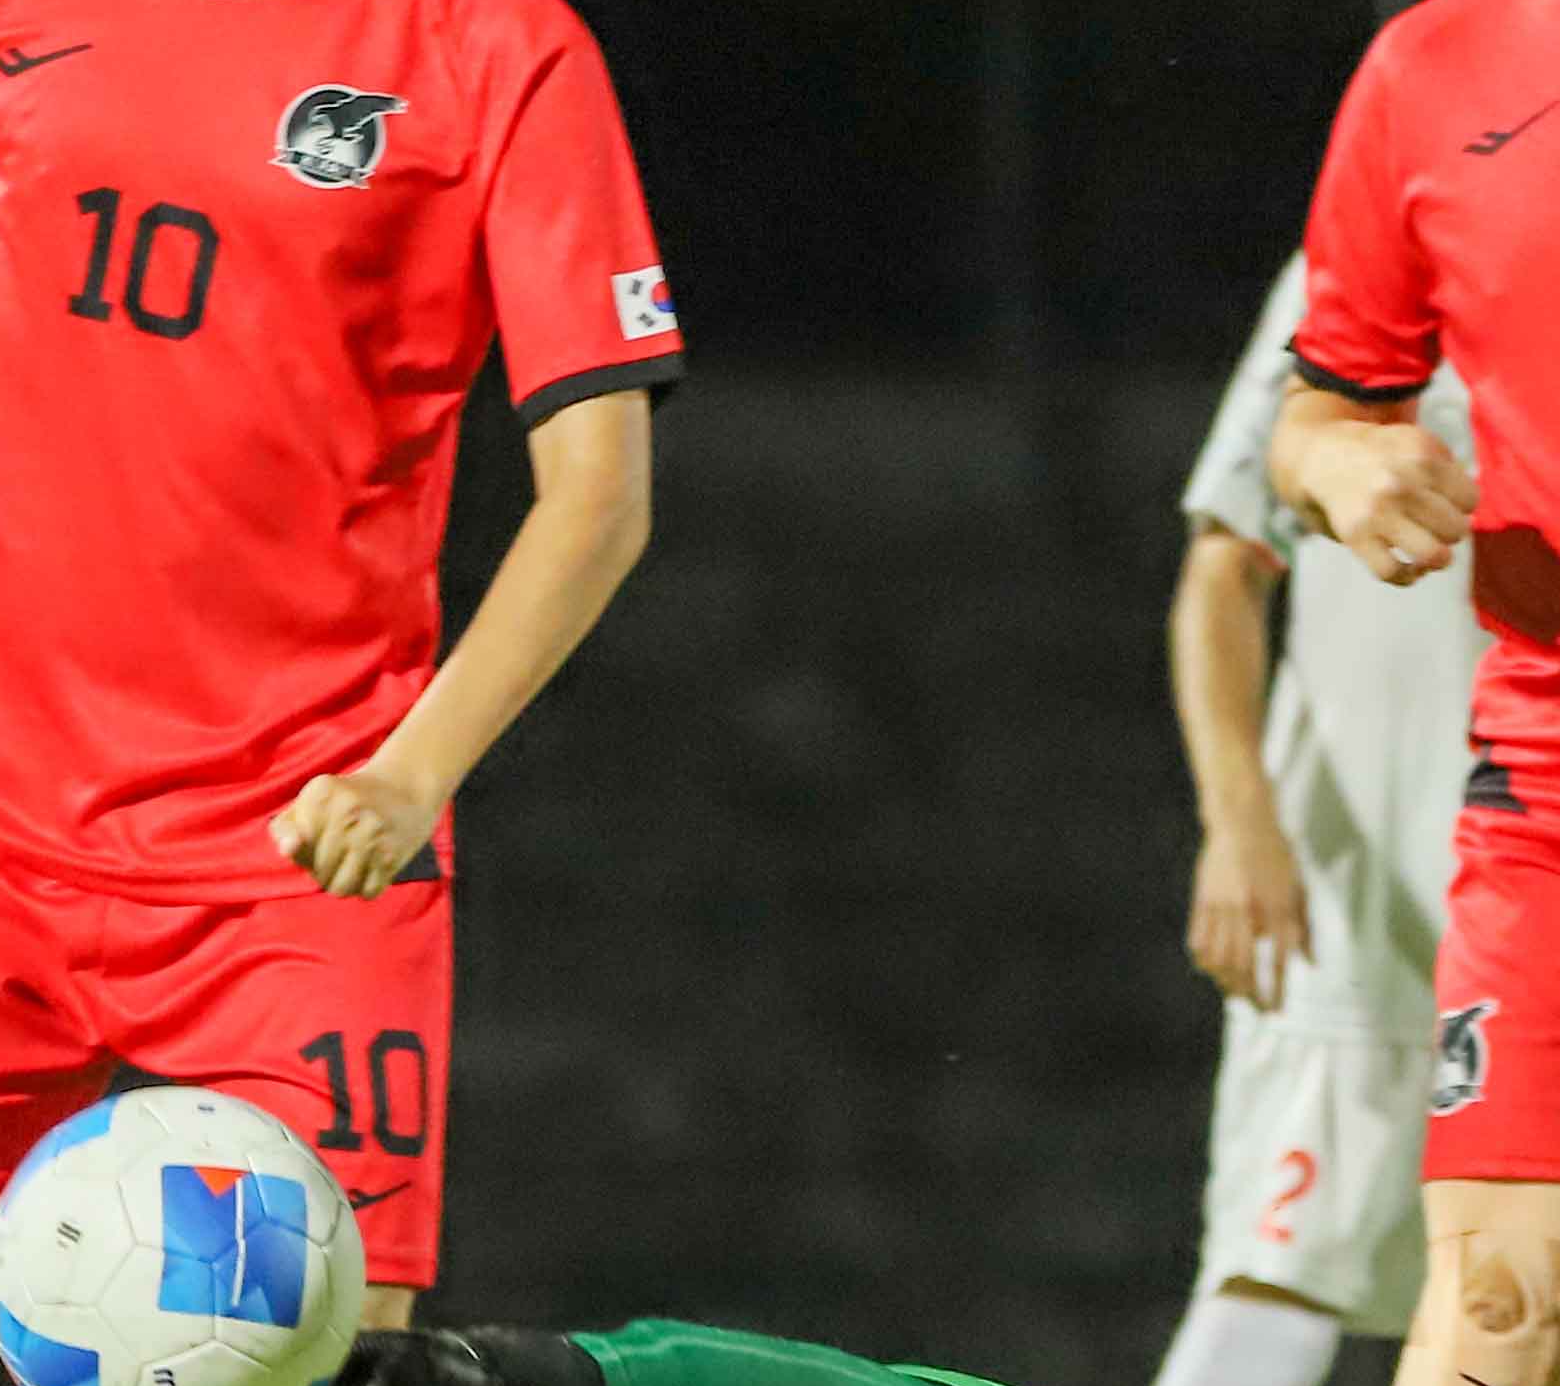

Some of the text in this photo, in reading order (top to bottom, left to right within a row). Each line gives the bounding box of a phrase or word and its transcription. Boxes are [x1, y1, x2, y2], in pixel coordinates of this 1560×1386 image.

[68, 186, 221, 341] 10
[299, 1028, 429, 1159] 10
[1257, 1146, 1320, 1245] 2
